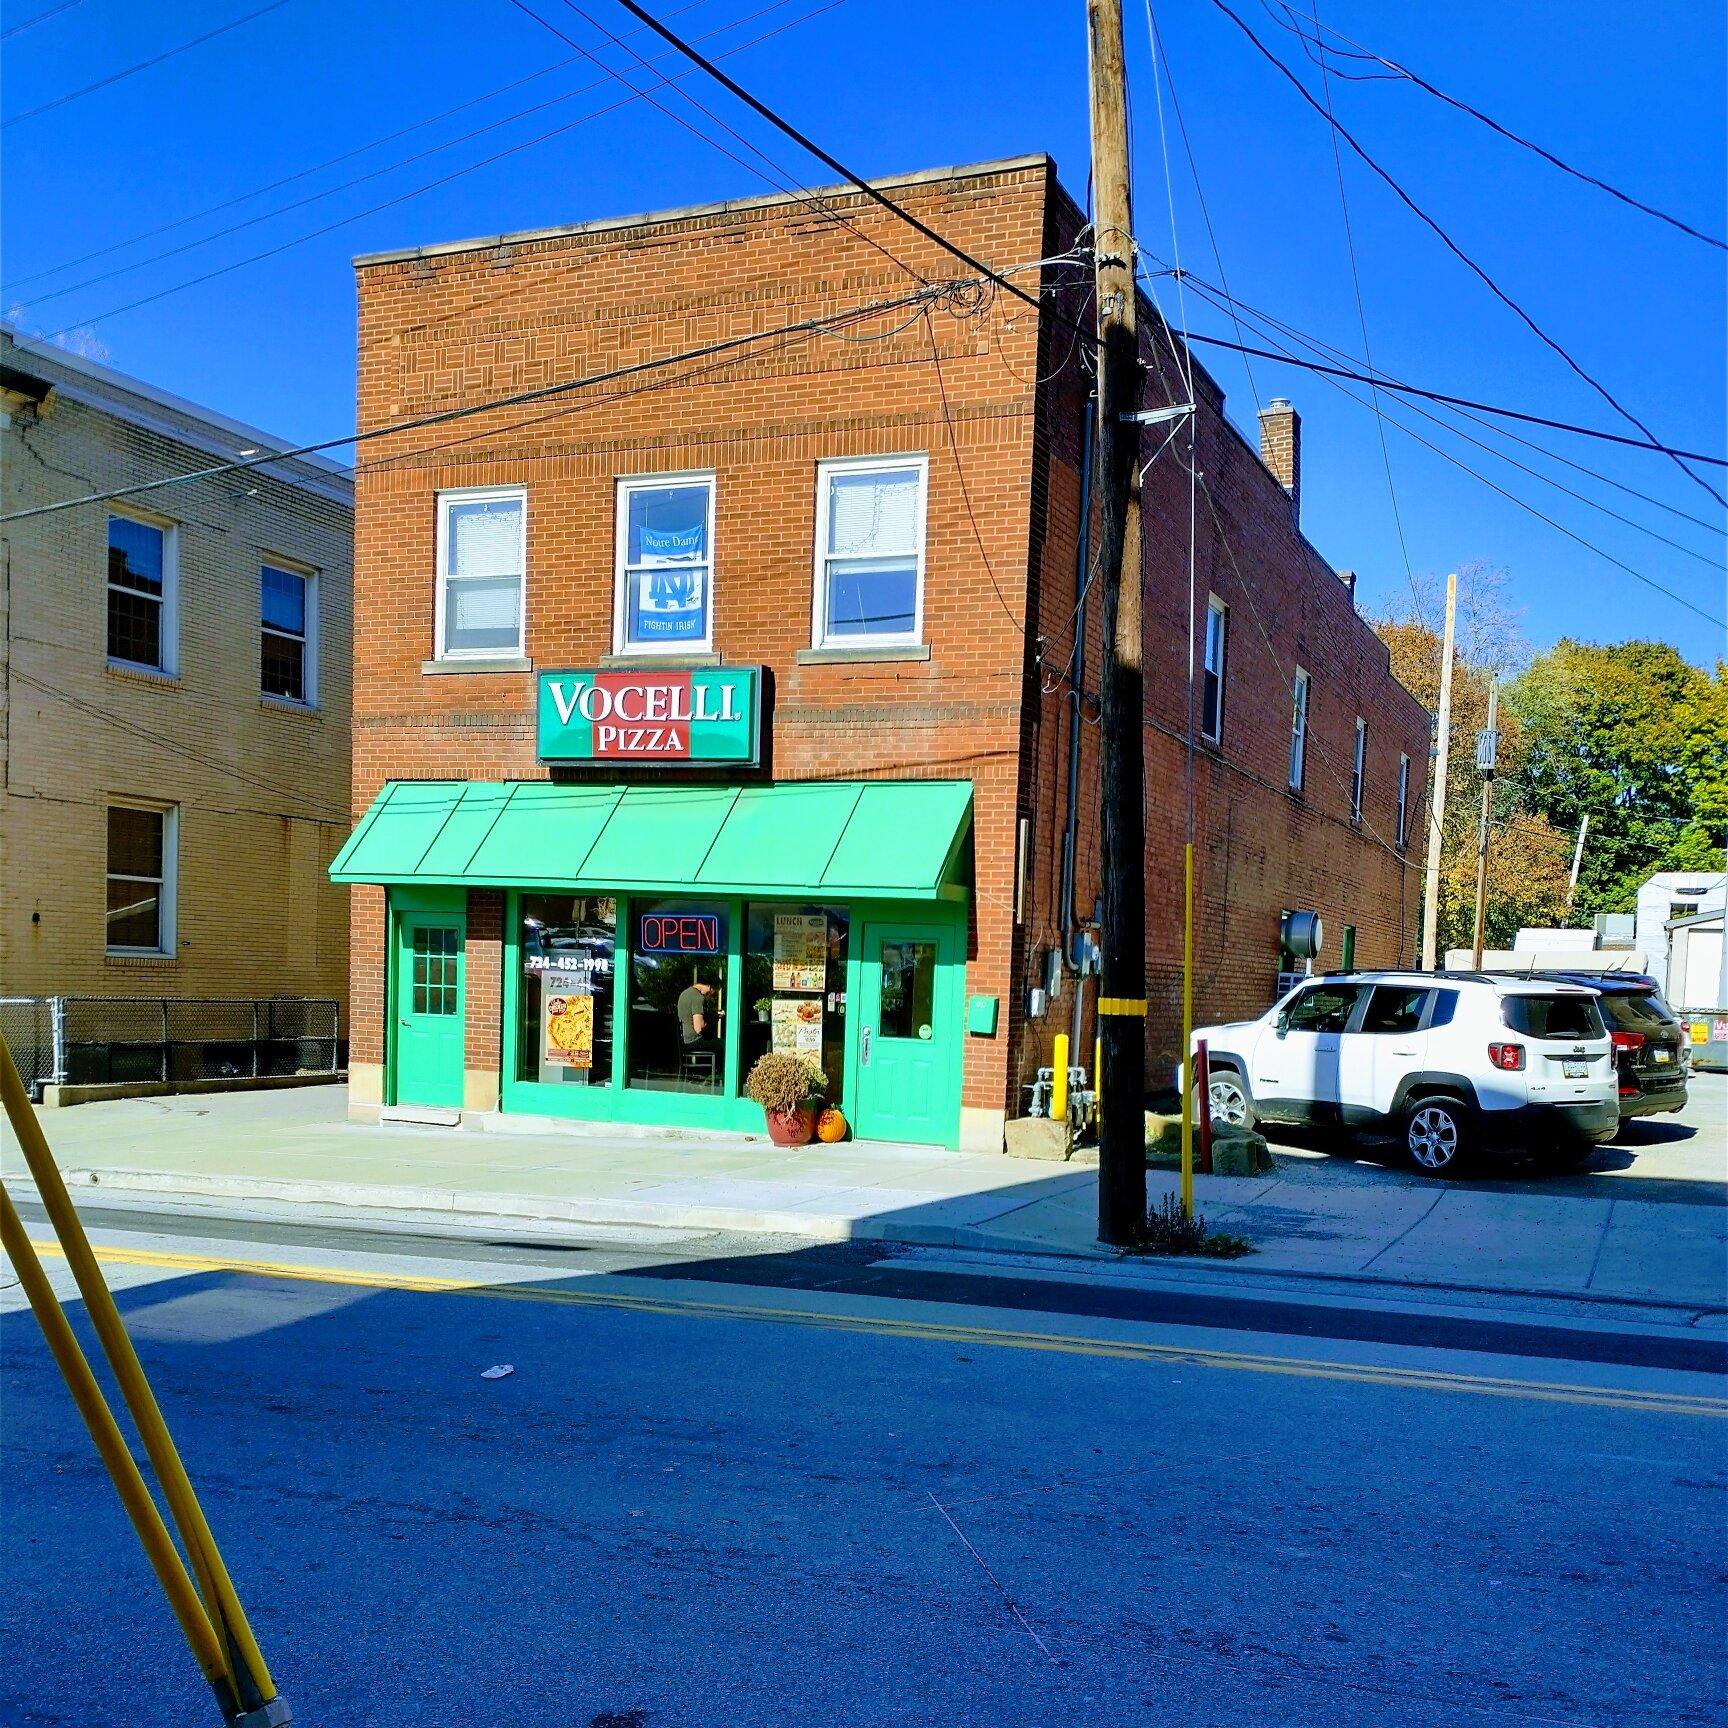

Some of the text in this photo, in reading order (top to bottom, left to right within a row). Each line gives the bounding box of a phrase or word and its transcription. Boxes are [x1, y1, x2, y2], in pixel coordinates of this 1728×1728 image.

[645, 535, 671, 548] Notre
[676, 619, 696, 631] IRISH
[547, 682, 736, 725] VOCELLI
[597, 725, 684, 752] PIZZA
[776, 915, 803, 926] LUNCH
[644, 917, 715, 950] OPEN
